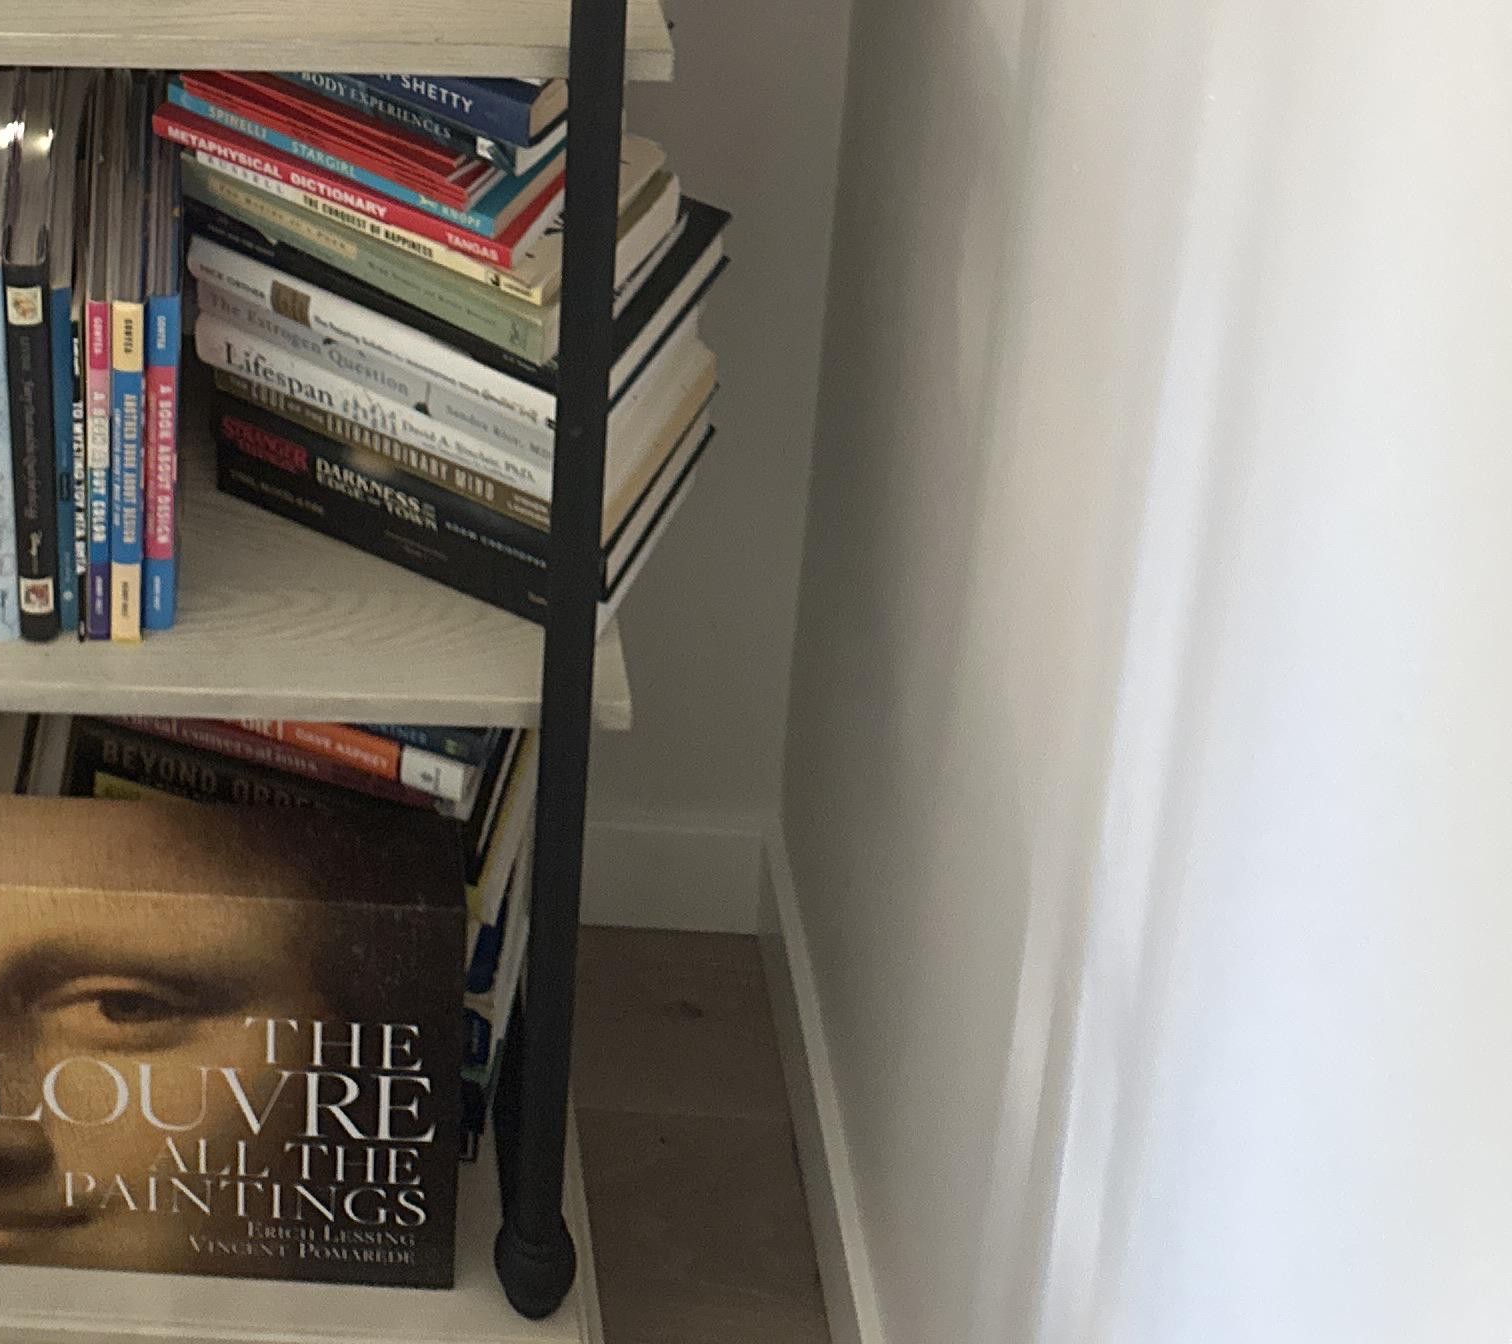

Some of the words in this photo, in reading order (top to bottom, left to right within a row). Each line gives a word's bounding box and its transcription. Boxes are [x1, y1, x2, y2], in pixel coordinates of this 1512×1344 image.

[167, 126, 283, 179] METAPHYSICAL
[290, 172, 388, 218] DICTIONARY
[224, 341, 334, 407] Lifespan
[246, 1016, 423, 1072] THE
[152, 1137, 269, 1179] ALL
[285, 1141, 421, 1185] THE
[64, 1172, 427, 1227] PAINTINGS
